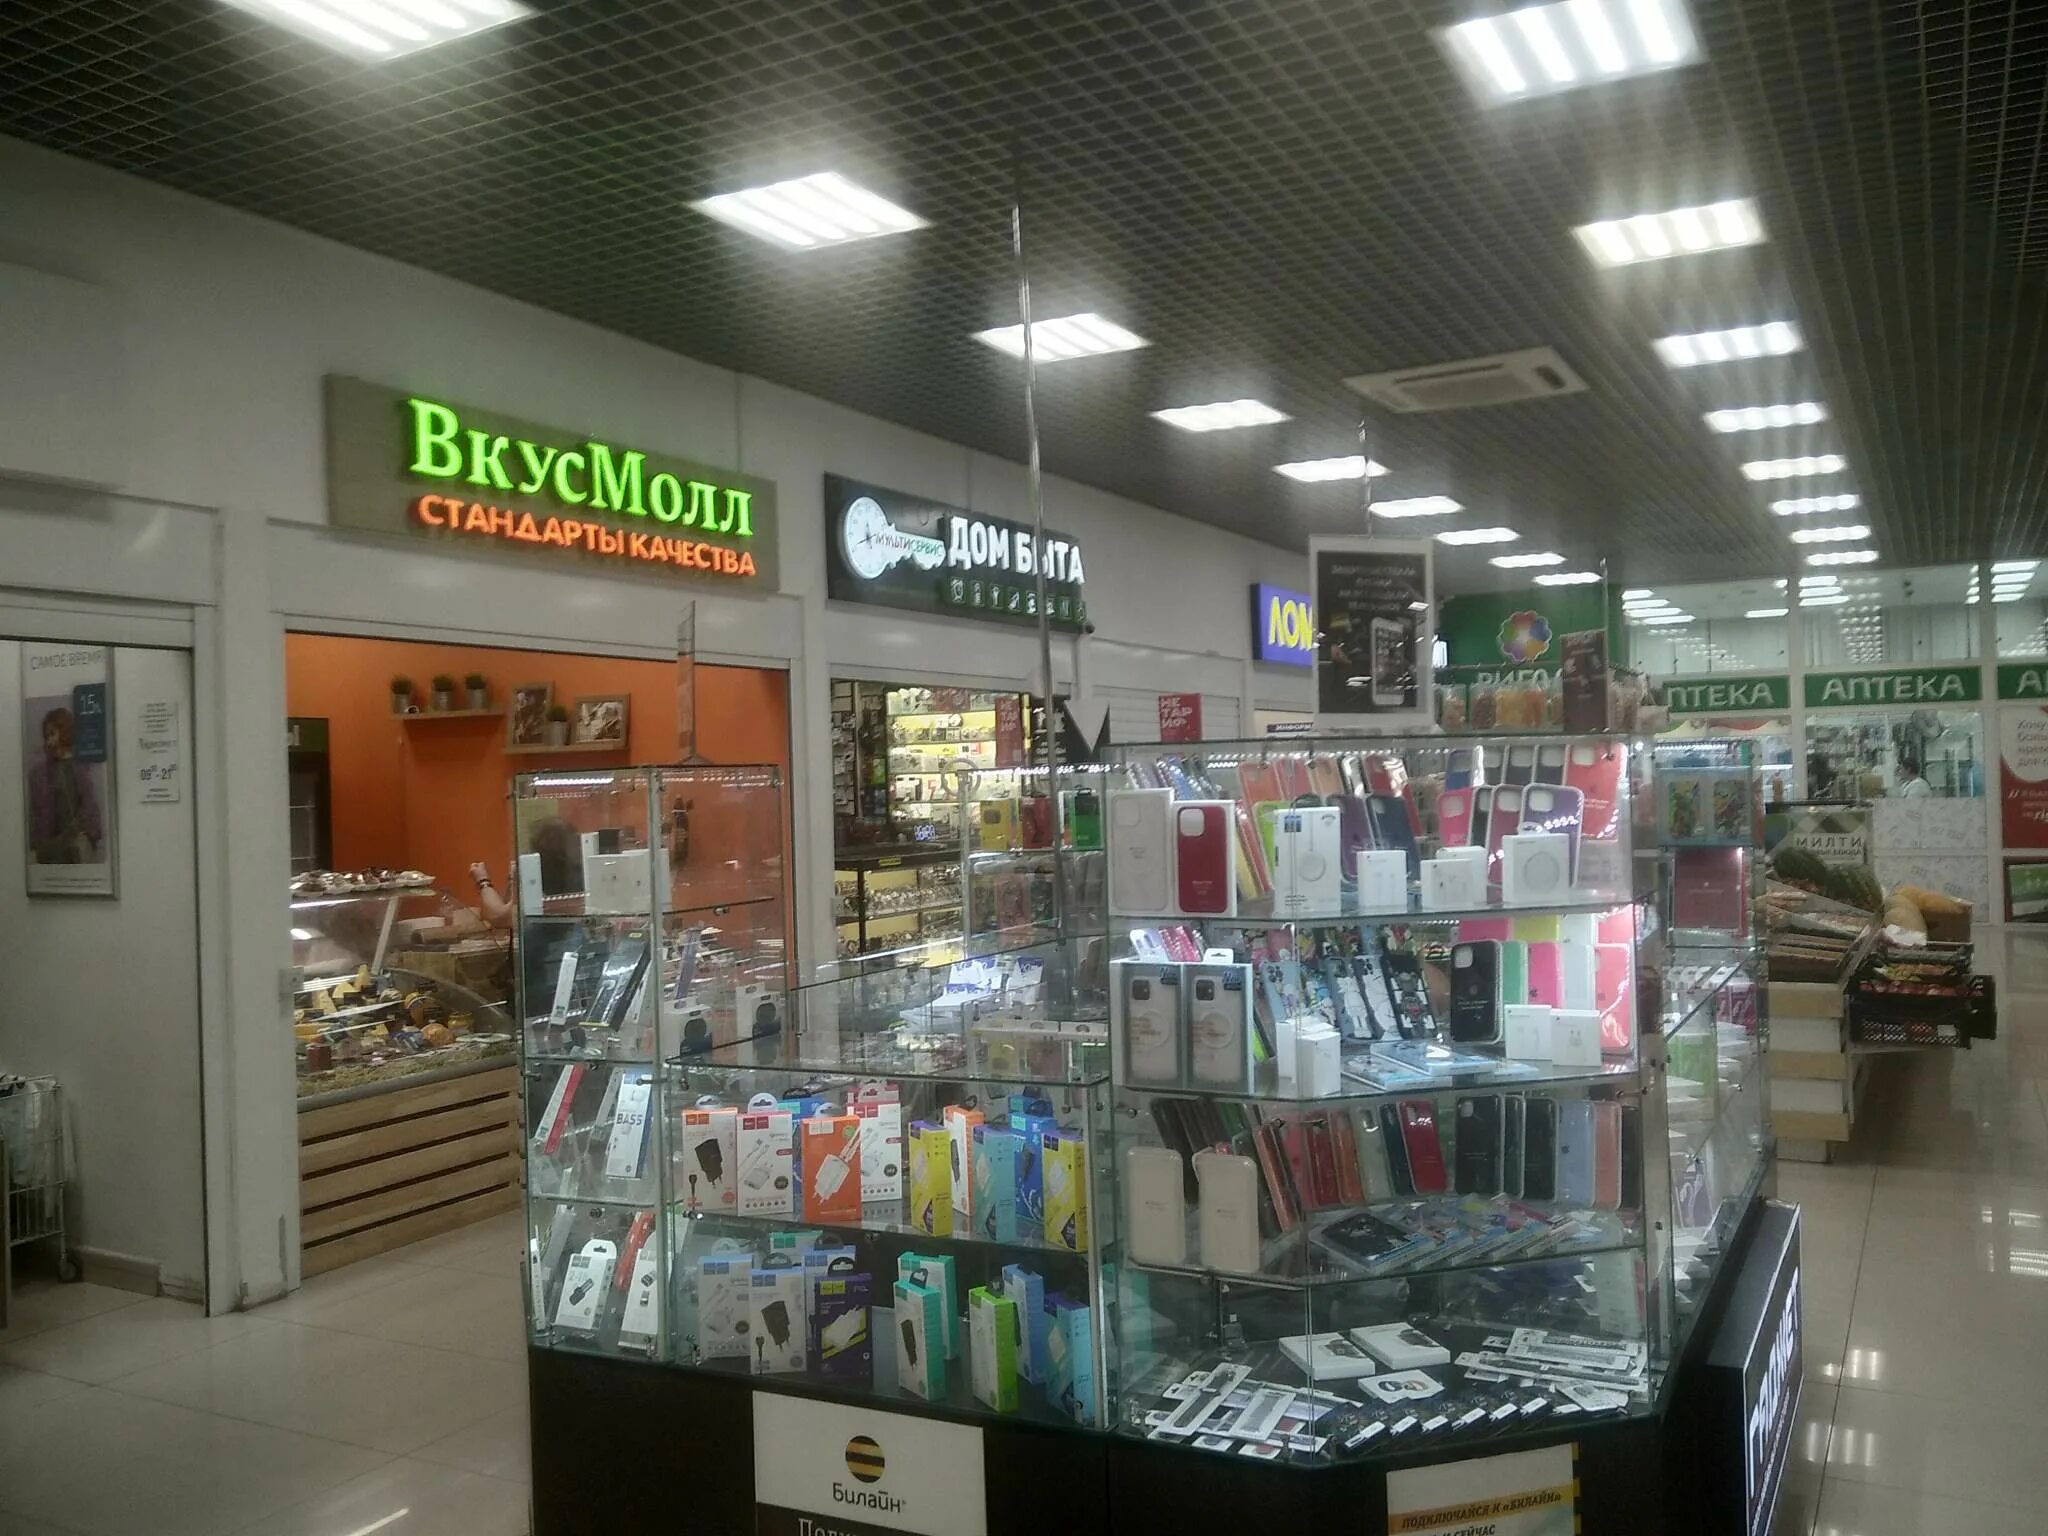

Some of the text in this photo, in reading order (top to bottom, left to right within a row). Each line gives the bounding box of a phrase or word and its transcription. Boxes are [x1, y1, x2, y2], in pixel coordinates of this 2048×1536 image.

[418, 494, 757, 576] СТАНДАРТЫ КАЧЕСТВА
[875, 532, 944, 557] МУЛЬТИСЕРВИС
[950, 516, 1086, 585] ДОМ БЫТА
[1268, 596, 1312, 652] ЛОМ
[1667, 682, 1774, 709] ПТЕКА
[1822, 674, 1966, 701] АПТЕКА
[1796, 836, 1863, 848] МИЛТИ
[616, 1113, 643, 1126] BASS
[1749, 1266, 1799, 1499] ГАДЖЕТ
[832, 1482, 902, 1513] Билайн
[1402, 1504, 1490, 1529] ПОДКЛЮЧАЙСЯ
[1454, 1524, 1496, 1536] СЕЙЧАС
